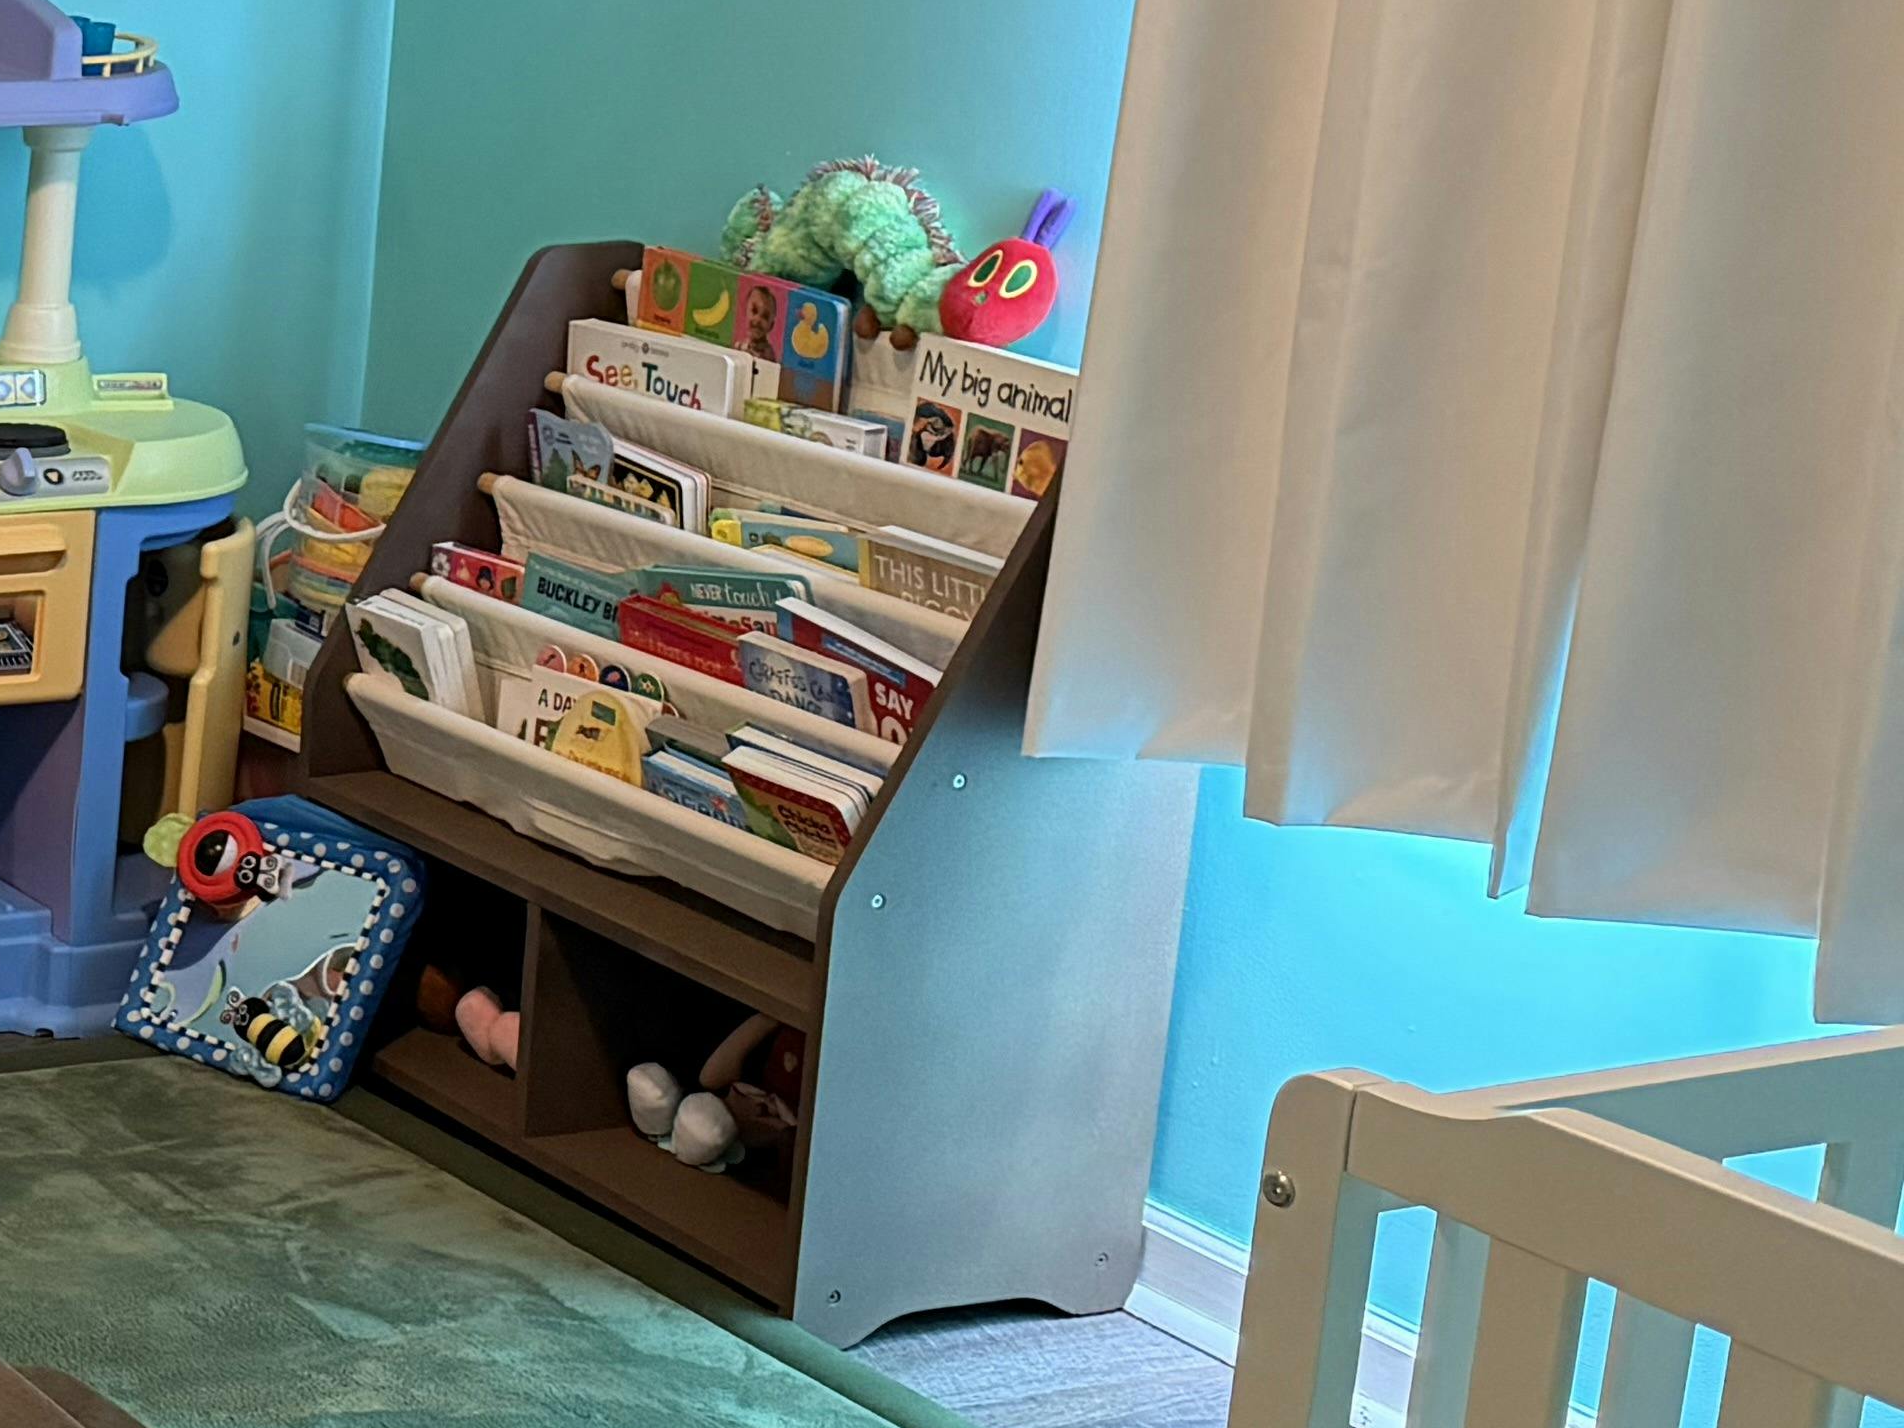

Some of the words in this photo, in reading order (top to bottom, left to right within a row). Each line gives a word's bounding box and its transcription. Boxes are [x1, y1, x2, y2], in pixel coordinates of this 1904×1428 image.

[641, 362, 702, 411] Touch
[919, 350, 957, 397] My
[961, 361, 992, 408] big
[997, 383, 1073, 423] animal
[873, 555, 925, 590] THIS
[537, 577, 601, 613] BUCKLEY
[724, 581, 771, 607] touch
[538, 689, 549, 707] A
[553, 692, 576, 713] DA
[875, 682, 913, 720] SAY
